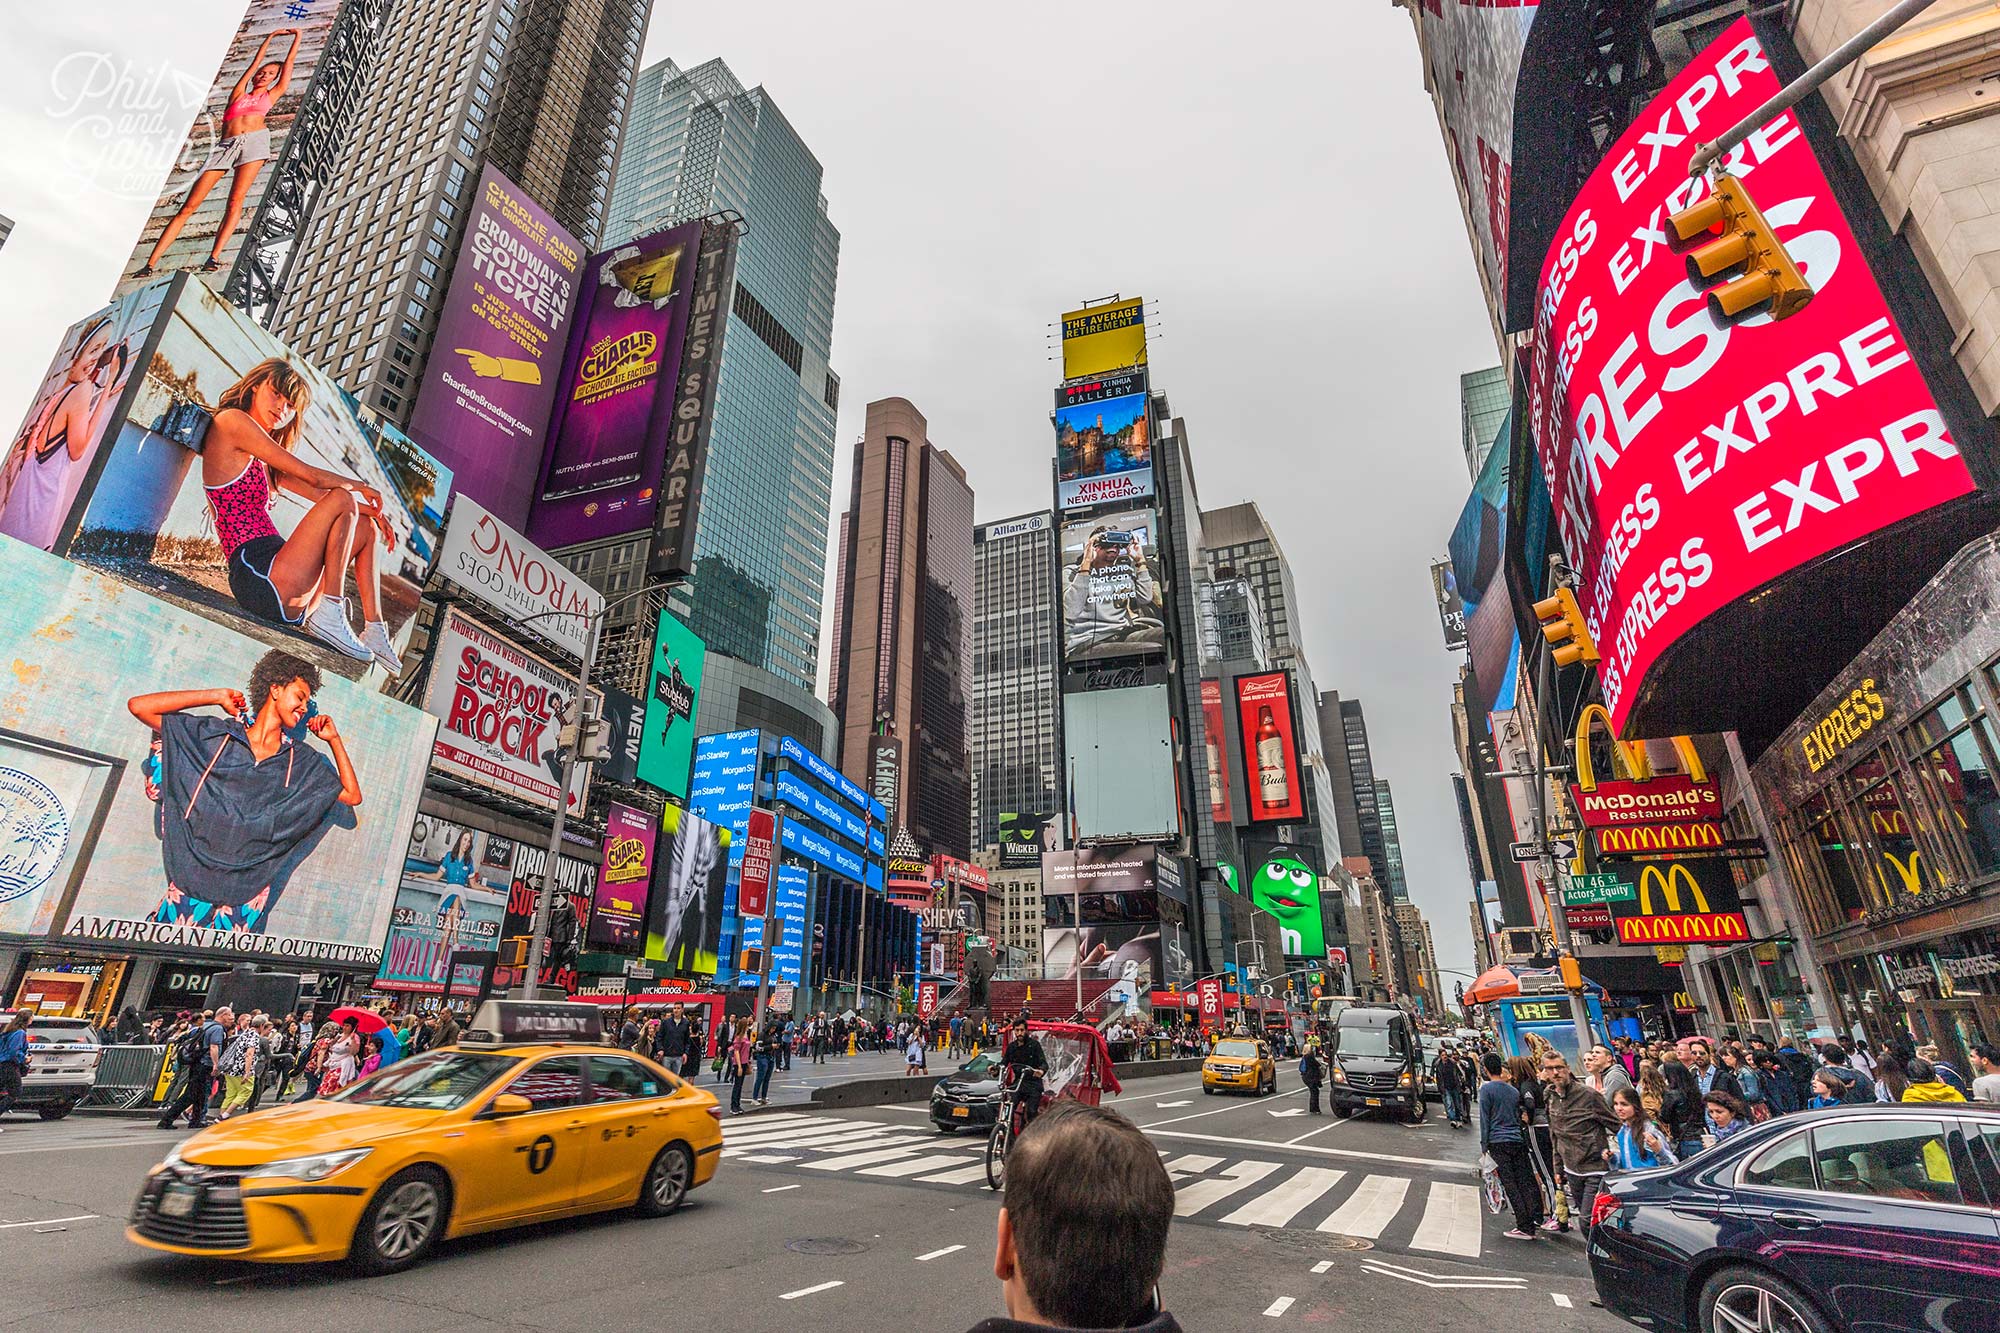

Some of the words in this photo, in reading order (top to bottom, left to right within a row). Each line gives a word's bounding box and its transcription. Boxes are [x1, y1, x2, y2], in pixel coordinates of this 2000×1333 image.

[1611, 36, 1771, 203] EXPR
[1608, 107, 1801, 296] EXPRE
[485, 190, 501, 212] THE
[501, 203, 544, 247] CHOCOLATE
[545, 240, 576, 273] FACTORY
[488, 181, 547, 236] CHARLIE
[550, 234, 578, 263] AND
[478, 212, 571, 298] BROADWAY'S
[471, 245, 563, 330] TICKET
[474, 233, 568, 316] GOLDEN
[690, 249, 724, 360] TIMES
[1536, 209, 1598, 387] EXPRESS
[474, 282, 485, 296] IS
[486, 292, 511, 315] JUST
[511, 307, 548, 343] AROUND
[482, 299, 501, 317] THE
[501, 312, 538, 346] CORNER
[1066, 318, 1086, 330] THE
[1090, 307, 1138, 325] AVERAGE
[471, 303, 487, 318] ON
[509, 330, 543, 359] STREET
[1066, 316, 1133, 338] RETIREMENT
[582, 333, 653, 378] CHARLIE
[585, 372, 625, 395] CHOCOLATE
[627, 364, 656, 380] FACTORY
[1103, 377, 1131, 388] XINHUA
[1550, 296, 1598, 457] EXPRESS
[442, 371, 533, 437] CharlieOnBroadway.com
[1069, 385, 1131, 404] GALLERY
[1673, 317, 1910, 495] EXPRE
[663, 372, 701, 529] SQUARE
[1079, 477, 1133, 495] XINHUA
[1733, 409, 1959, 553] EXPR
[1067, 494, 1098, 506] NEWS
[1100, 485, 1146, 500] AGENCY
[993, 522, 1027, 537] Allianz
[657, 547, 676, 558] NYC
[1594, 483, 1661, 623] EXPRESS
[457, 551, 504, 593] GOES
[471, 514, 589, 630] WRONG
[1089, 576, 1109, 584] that
[1110, 574, 1129, 583] can
[1091, 567, 1098, 576] A
[1099, 563, 1130, 577] phone
[504, 585, 537, 614] THAT
[1087, 591, 1137, 604] anywhere
[1091, 584, 1112, 594] take
[1113, 582, 1133, 594] you
[1616, 537, 1713, 678] EXPRESS
[480, 636, 501, 654] LLOYD
[501, 646, 526, 668] WEBBER
[526, 661, 538, 677] HAS
[538, 666, 569, 693] BROADWAY
[457, 646, 552, 722] SCHOOL
[494, 698, 517, 721] of
[446, 682, 547, 767] ROCK
[624, 705, 645, 762] NEW
[726, 730, 749, 740] Morgan
[1801, 678, 1885, 773] EXPRESS
[706, 750, 730, 760] Stanley
[783, 740, 803, 761] Stanley
[454, 750, 470, 764] JUST
[474, 756, 494, 774] BLOCKS
[494, 764, 502, 776] TO
[502, 768, 513, 781] THE
[513, 771, 532, 789] WINTER
[533, 779, 550, 796] GARDEN
[722, 765, 746, 775] Morgan
[702, 786, 726, 795] Stanley
[1585, 788, 1716, 812] McDonald's
[718, 802, 742, 812] Morgan
[1608, 806, 1698, 821] Restaurant
[608, 841, 643, 867] CHARLIE
[746, 845, 771, 860] MIDLER
[748, 836, 771, 850] BETTE
[1518, 847, 1536, 857] ONE
[1096, 870, 1112, 878] front
[1107, 861, 1120, 869] with
[1121, 860, 1143, 868] heated
[1574, 878, 1585, 889] W
[1590, 876, 1605, 888] 46
[1609, 875, 1617, 883] St
[1600, 885, 1629, 898] Equity
[398, 909, 431, 927] SARA
[436, 915, 495, 937] BAREILLES
[69, 916, 208, 947] AMERICAN
[211, 930, 275, 955] EAGLE
[279, 939, 382, 965] OUTFITTERS
[1894, 965, 1936, 987] EXPRESS
[1948, 953, 1999, 978] EXPRESS
[922, 985, 934, 1013] tkts
[1203, 983, 1218, 1014] tkts
